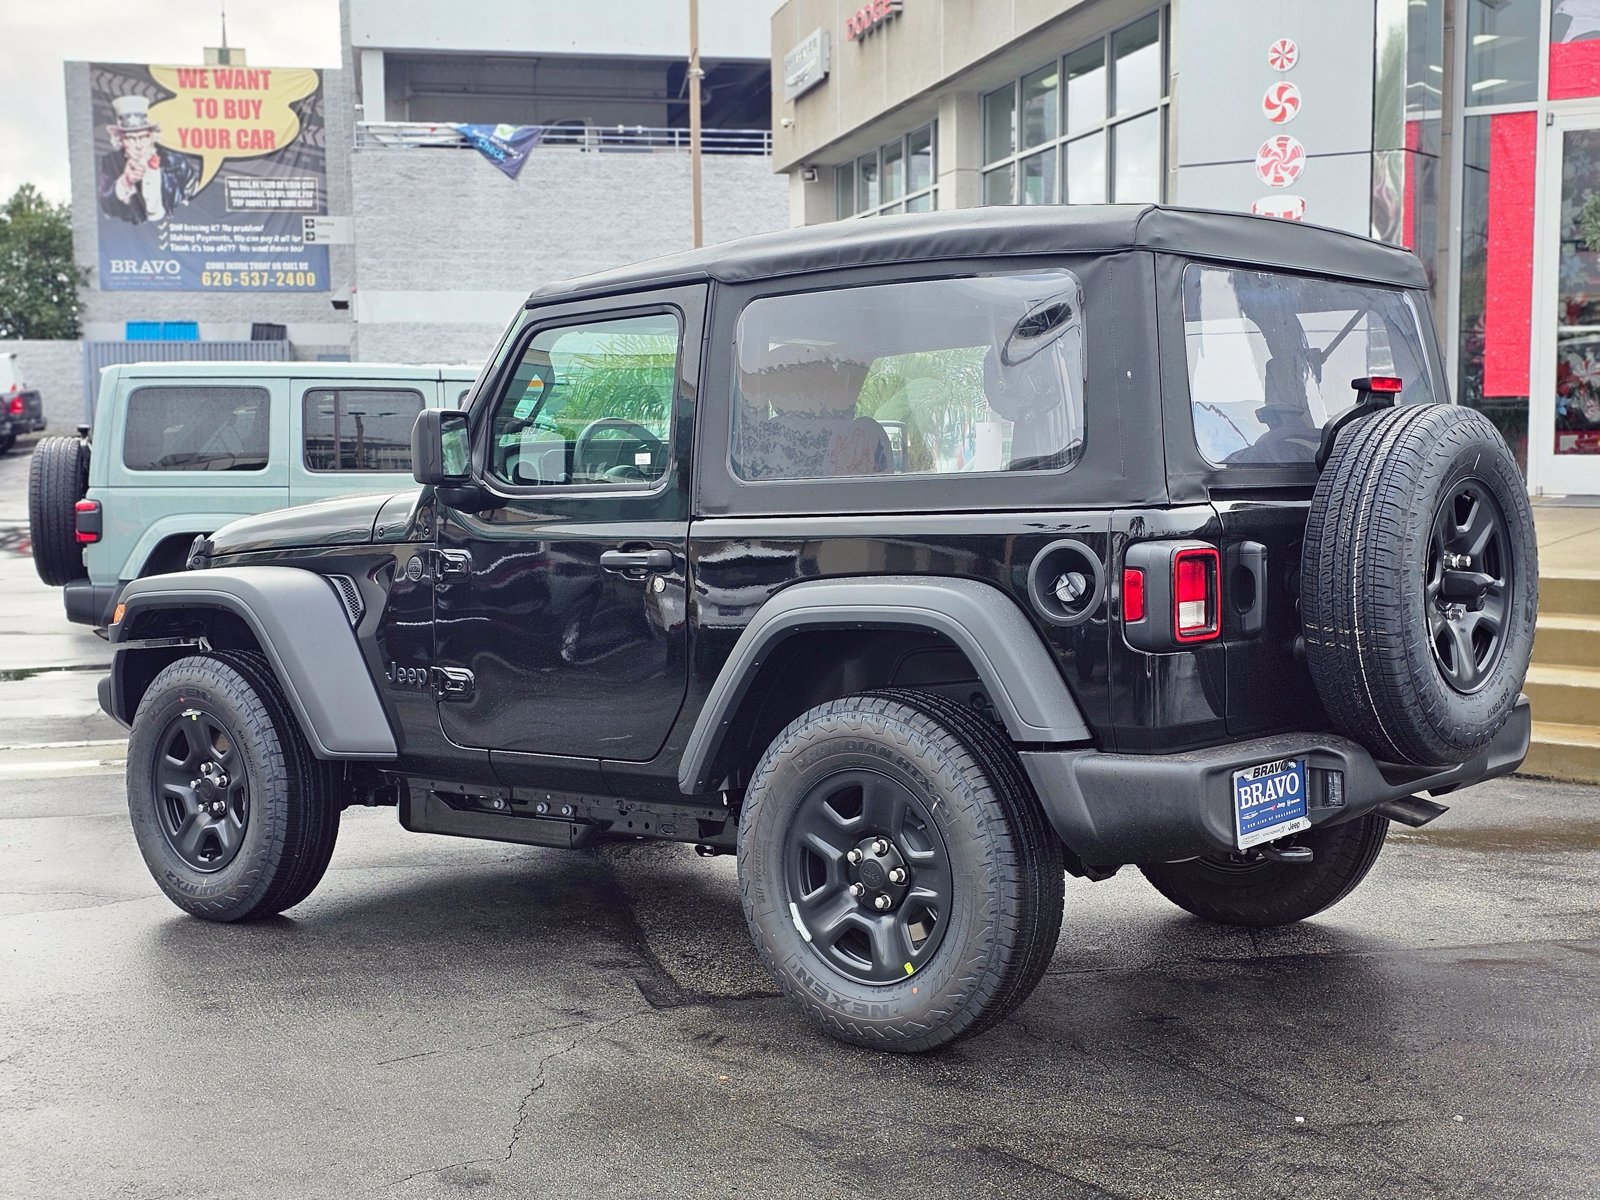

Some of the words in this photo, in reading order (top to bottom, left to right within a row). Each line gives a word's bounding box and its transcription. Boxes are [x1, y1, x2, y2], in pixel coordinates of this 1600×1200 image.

[177, 68, 209, 89] WE
[213, 69, 272, 90] WANT
[193, 98, 218, 119] TO
[223, 99, 263, 120] BUY
[178, 127, 231, 149] YOUR
[236, 129, 276, 150] CAR
[110, 259, 181, 274] BRAVO
[202, 271, 316, 286] 626-537-2400
[385, 661, 428, 689] Jeep
[1253, 759, 1290, 779] BRAVO
[1239, 772, 1300, 810] BRAVO
[1288, 821, 1301, 831] Jeep
[796, 970, 890, 1017] NEXEN
